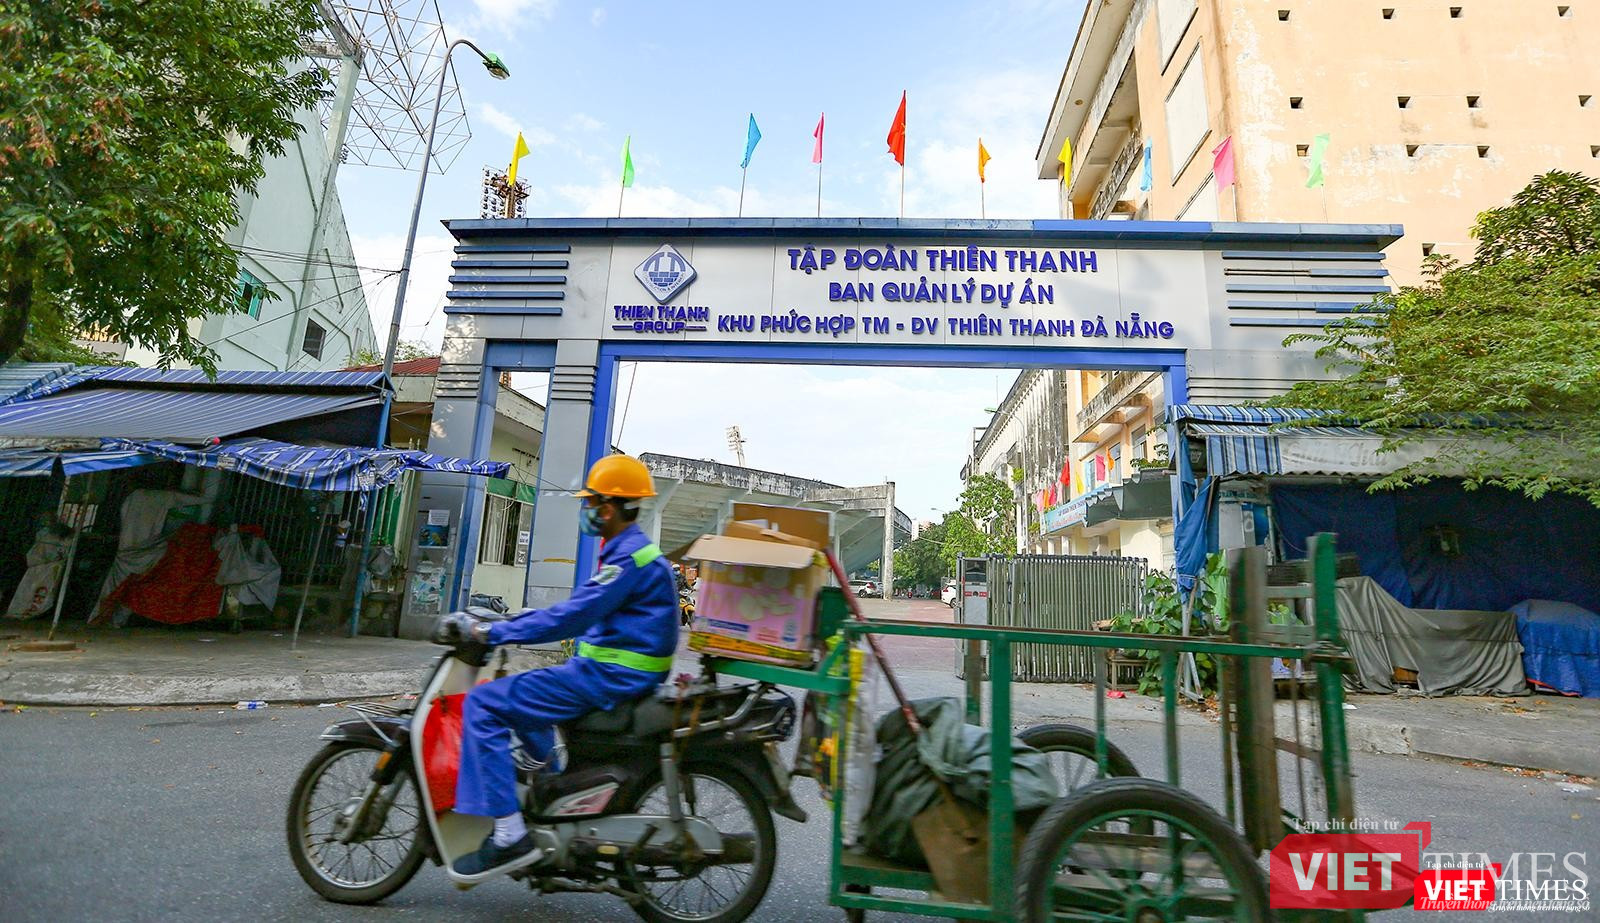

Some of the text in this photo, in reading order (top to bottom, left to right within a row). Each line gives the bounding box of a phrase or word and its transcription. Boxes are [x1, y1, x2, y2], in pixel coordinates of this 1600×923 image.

[788, 243, 1098, 274] TẬP ĐOÀN THIÊN THANH
[829, 276, 1054, 308] BAN QUẢN LÝ DỰ ÁN
[632, 320, 685, 333] GROUP
[657, 306, 709, 322] THANH
[718, 315, 755, 332] KHU
[760, 309, 811, 333] PHỨC
[815, 314, 855, 338] HỢP
[862, 317, 890, 334] TM
[911, 318, 938, 335] DV
[948, 313, 1002, 336] THIÊN
[1009, 319, 1075, 337] THANH
[1081, 315, 1109, 338] ĐÀ
